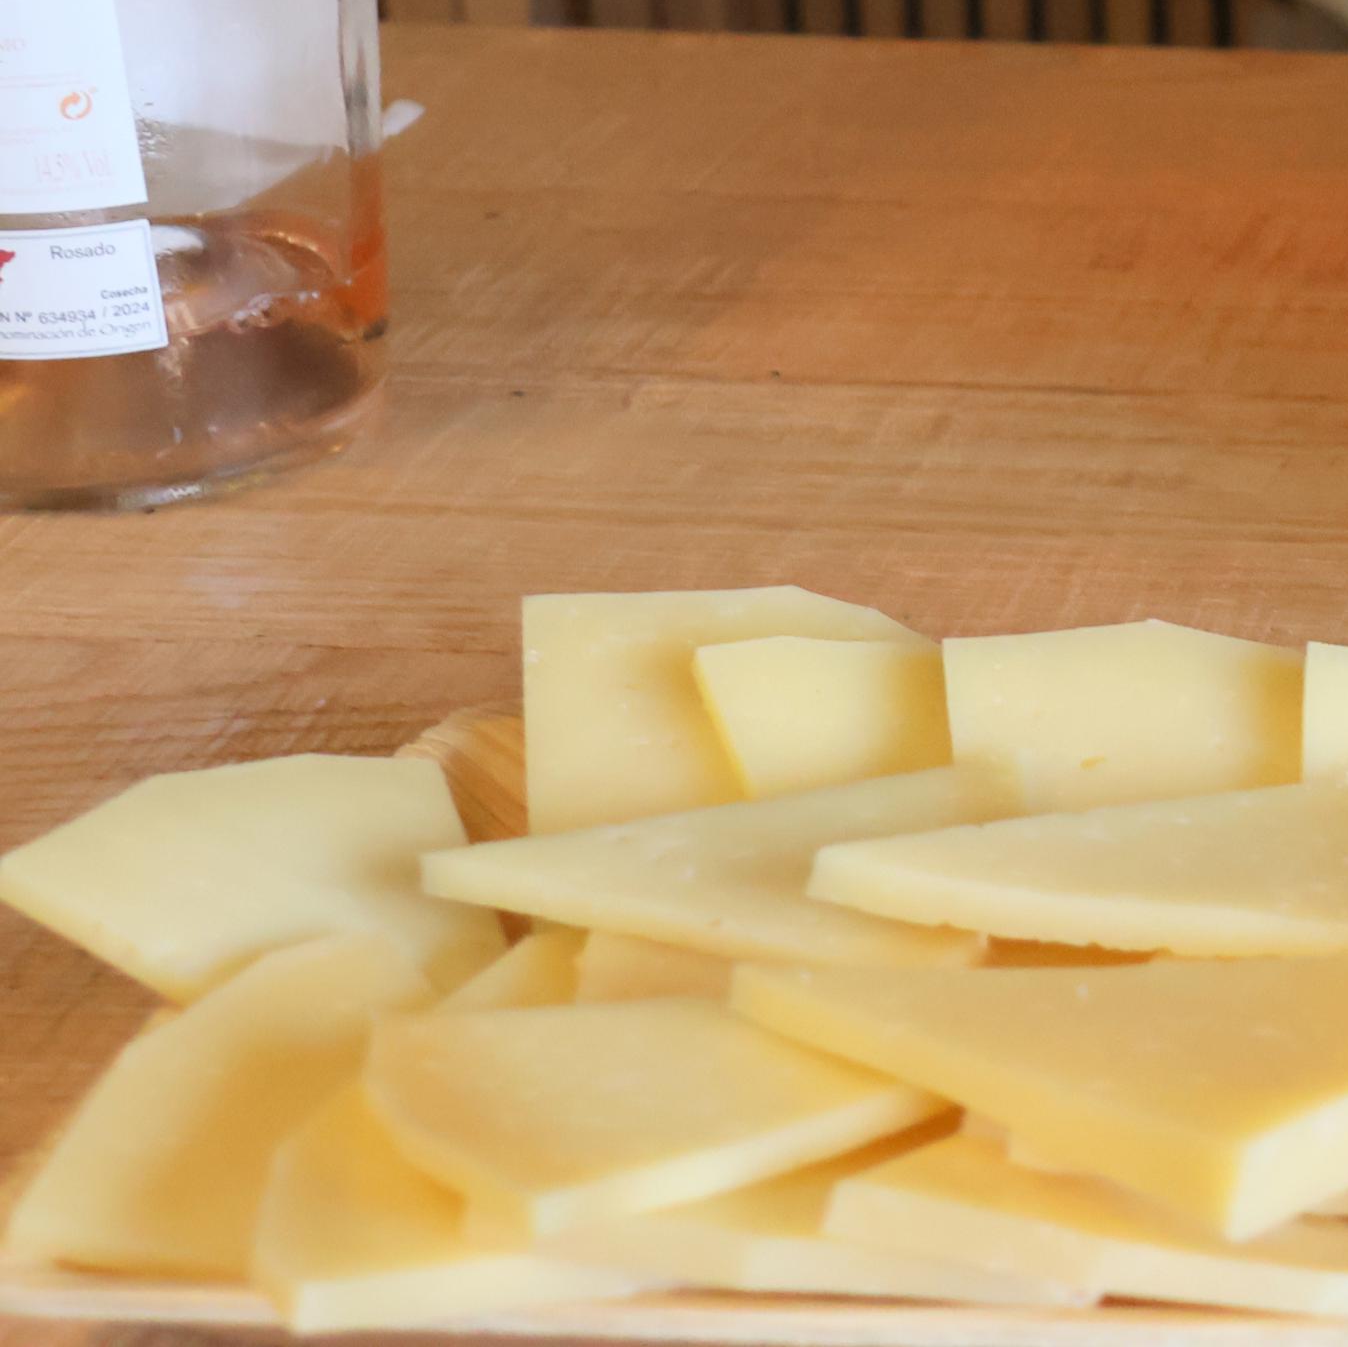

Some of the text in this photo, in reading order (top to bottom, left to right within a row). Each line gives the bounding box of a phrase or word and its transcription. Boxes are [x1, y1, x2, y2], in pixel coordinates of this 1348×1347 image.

[50, 242, 116, 259] Rosado
[101, 286, 148, 300] Cosecha
[112, 302, 150, 317] 2024
